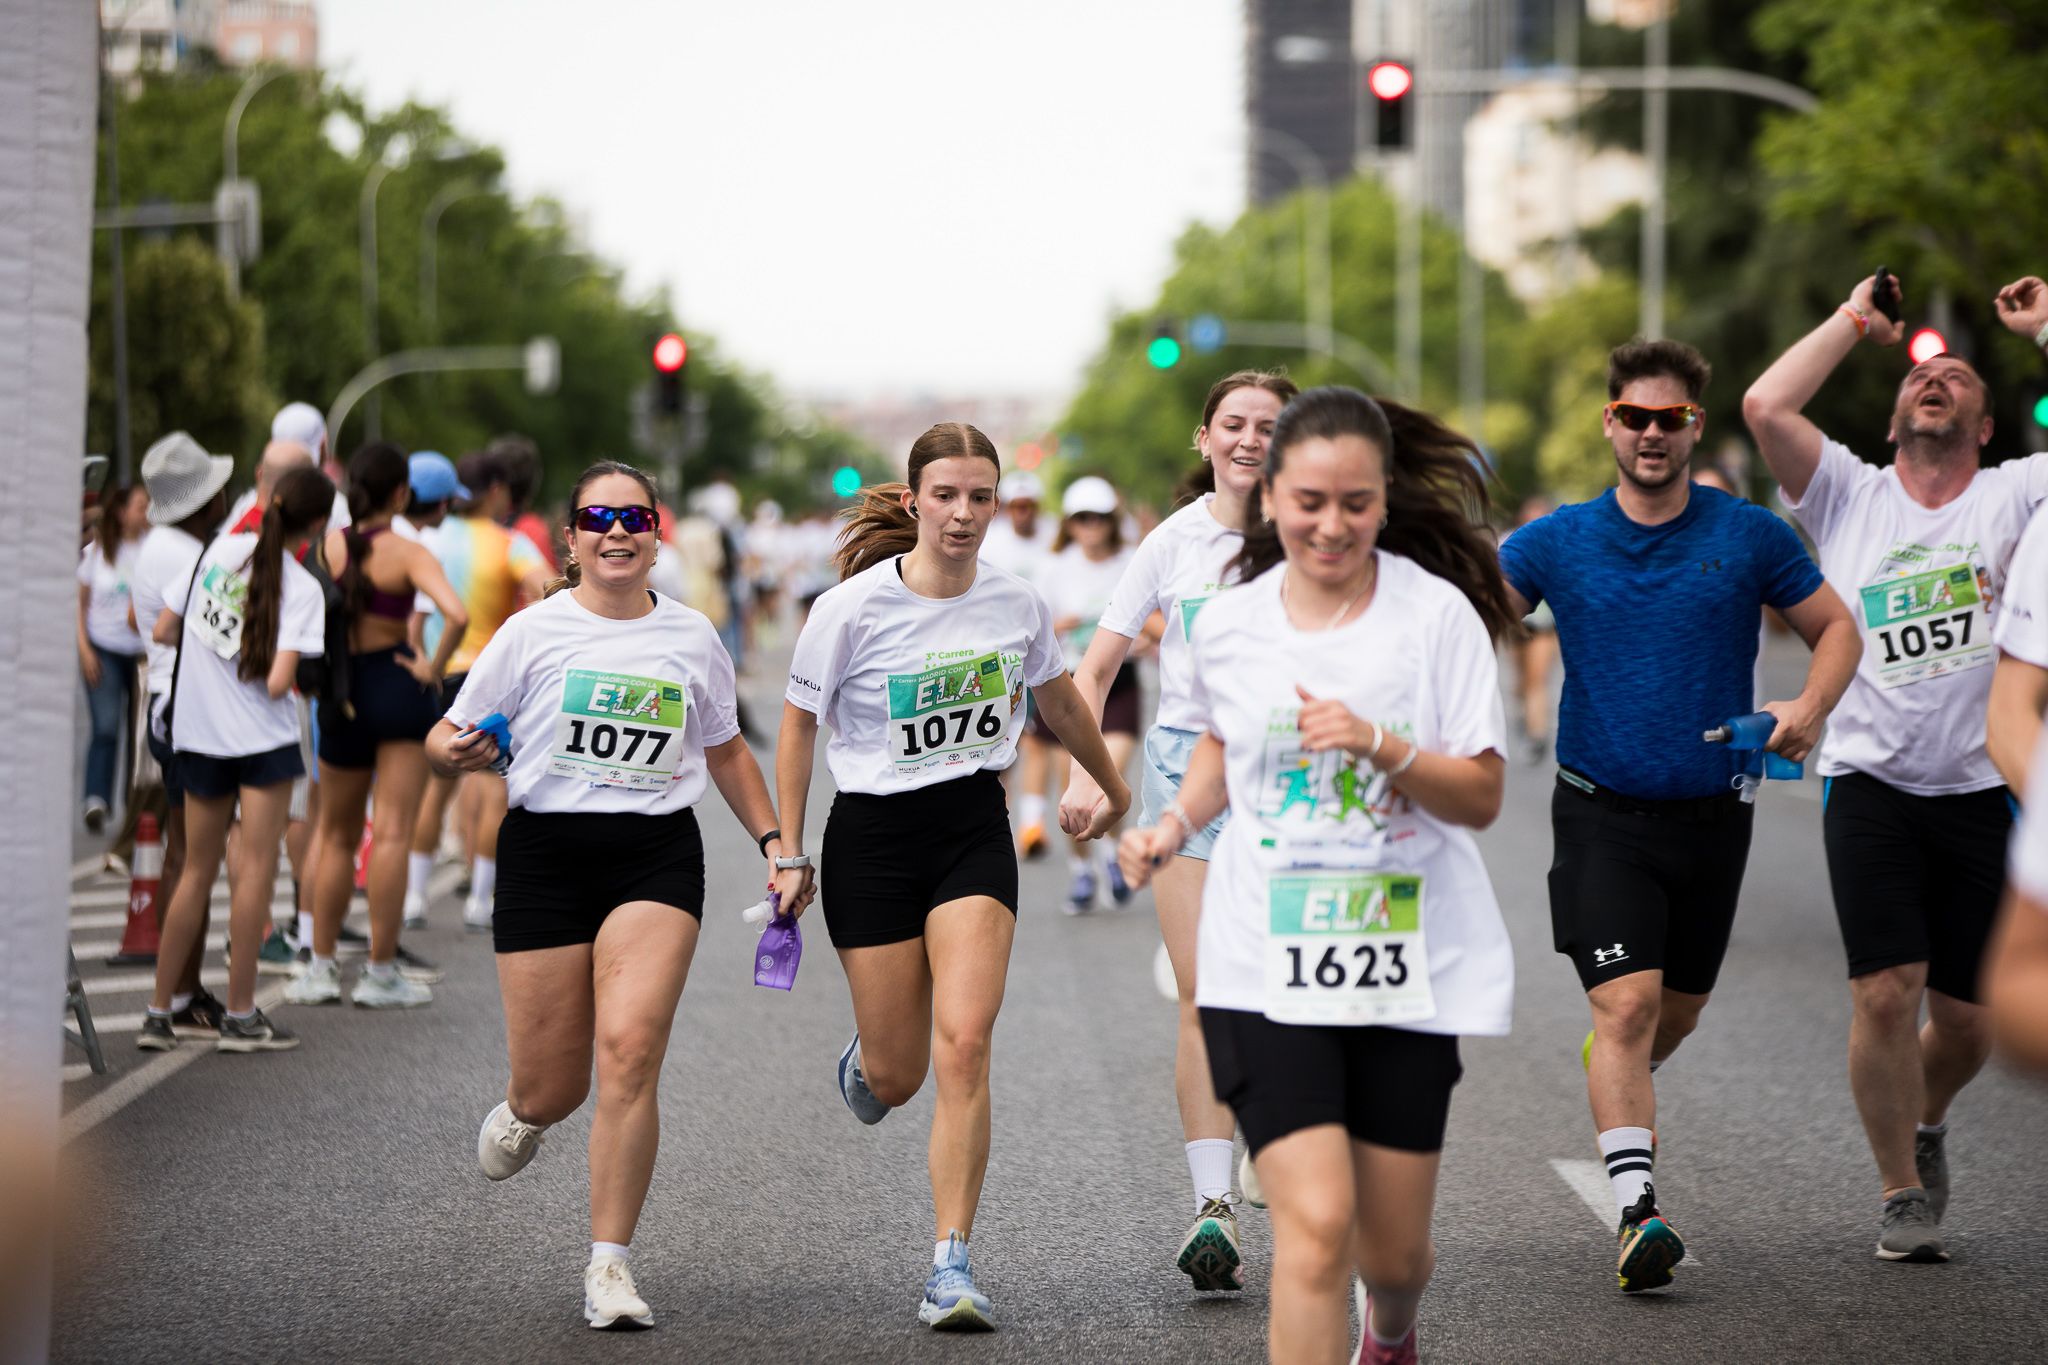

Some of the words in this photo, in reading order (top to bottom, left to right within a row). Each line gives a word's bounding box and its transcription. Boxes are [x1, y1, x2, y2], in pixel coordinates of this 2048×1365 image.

[1887, 580, 1953, 620] ELA
[938, 649, 975, 660] Carrera
[1879, 611, 1974, 664] 1057
[597, 674, 629, 685] MADRID
[630, 680, 647, 688] CON
[916, 670, 984, 712] ELA
[918, 670, 947, 683] MADRID
[948, 666, 964, 674] CON
[965, 663, 975, 671] LA
[588, 682, 661, 720] ELA
[565, 720, 673, 766] 1077
[902, 703, 1002, 756] 1076
[1302, 888, 1392, 931] ELA
[1286, 943, 1408, 988] 1623
